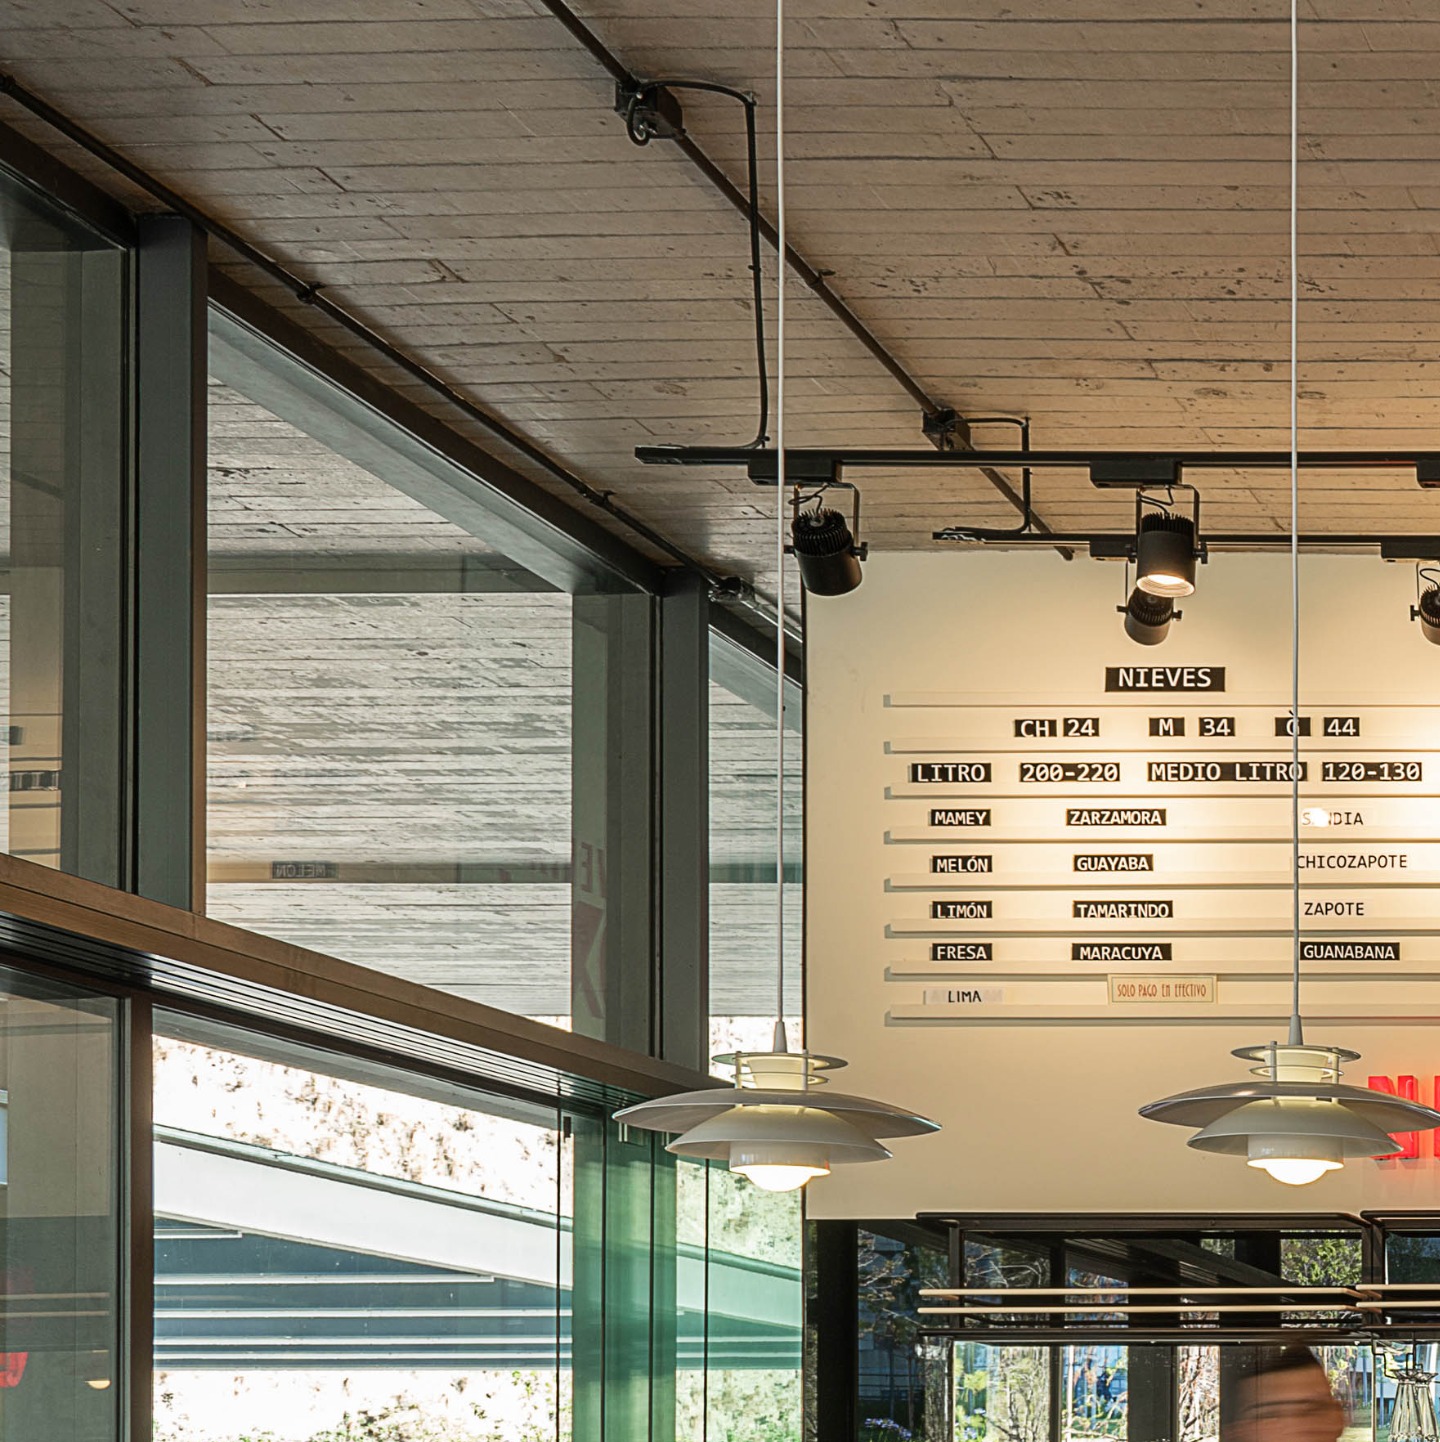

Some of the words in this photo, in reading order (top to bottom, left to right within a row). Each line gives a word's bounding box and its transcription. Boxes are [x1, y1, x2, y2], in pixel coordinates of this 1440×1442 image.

[1117, 668, 1212, 688] NIEVES
[1020, 719, 1050, 737] CH
[1067, 718, 1095, 737] 24
[1158, 719, 1174, 736] M
[1203, 718, 1231, 736] 34
[1286, 719, 1300, 736] G
[1328, 718, 1356, 736] 44
[916, 764, 985, 782] LITRO
[1023, 763, 1118, 783] 200-220
[1151, 763, 1221, 782] MEDIO
[1235, 763, 1304, 782] LITRO
[1324, 763, 1420, 782] 120-130
[934, 811, 986, 826] MAMEY
[1069, 810, 1163, 826] ZARZAMORA
[1302, 812, 1364, 826] SDIA
[936, 855, 989, 873] MELÓN
[1076, 855, 1149, 872] GUAYABA
[1296, 854, 1408, 870] CHICOZAPOTE
[936, 901, 988, 919] LIMÓN
[1077, 902, 1170, 919] TAMARINDO
[1304, 901, 1365, 917] ZAPOTE
[936, 945, 987, 960] FRESA
[1079, 945, 1163, 960] MARACUYA
[1303, 944, 1396, 960] GUANABANA
[948, 990, 982, 1003] LIMA
[1117, 983, 1136, 997] SOLO
[1138, 983, 1157, 997] PAGO
[1161, 983, 1171, 997] EN
[1174, 983, 1207, 997] EFECTIVO
